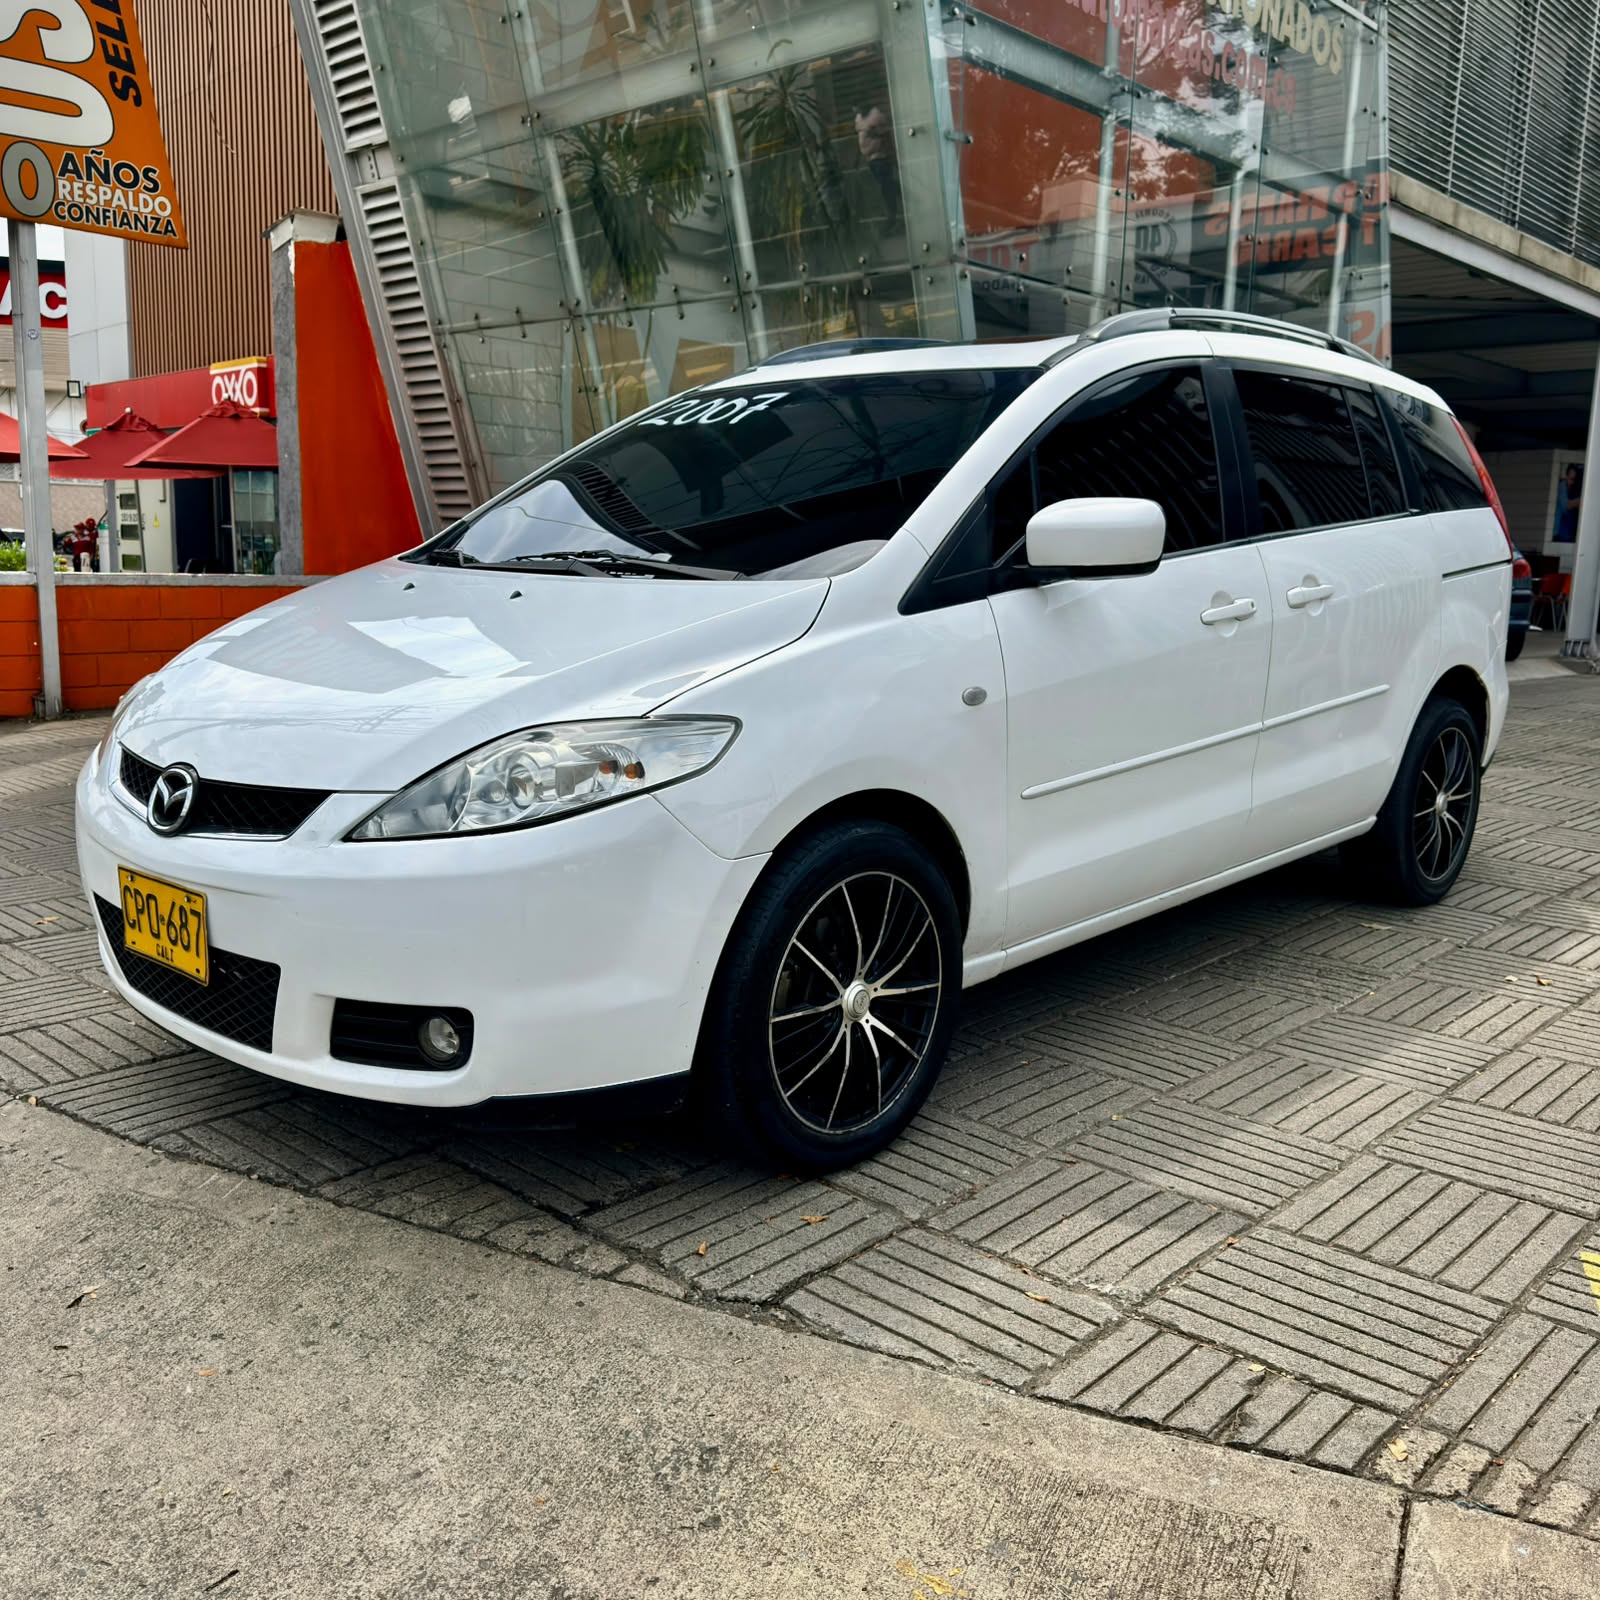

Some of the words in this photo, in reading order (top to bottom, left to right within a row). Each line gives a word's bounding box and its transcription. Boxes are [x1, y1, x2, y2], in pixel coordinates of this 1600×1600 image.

[57, 148, 161, 194] AÑOS
[57, 179, 172, 217] RESPALDO
[53, 201, 179, 238] CONFIANZA
[211, 368, 258, 407] OXXO
[637, 392, 791, 426] 2007
[166, 901, 202, 958] 687
[156, 943, 174, 963] CALI
